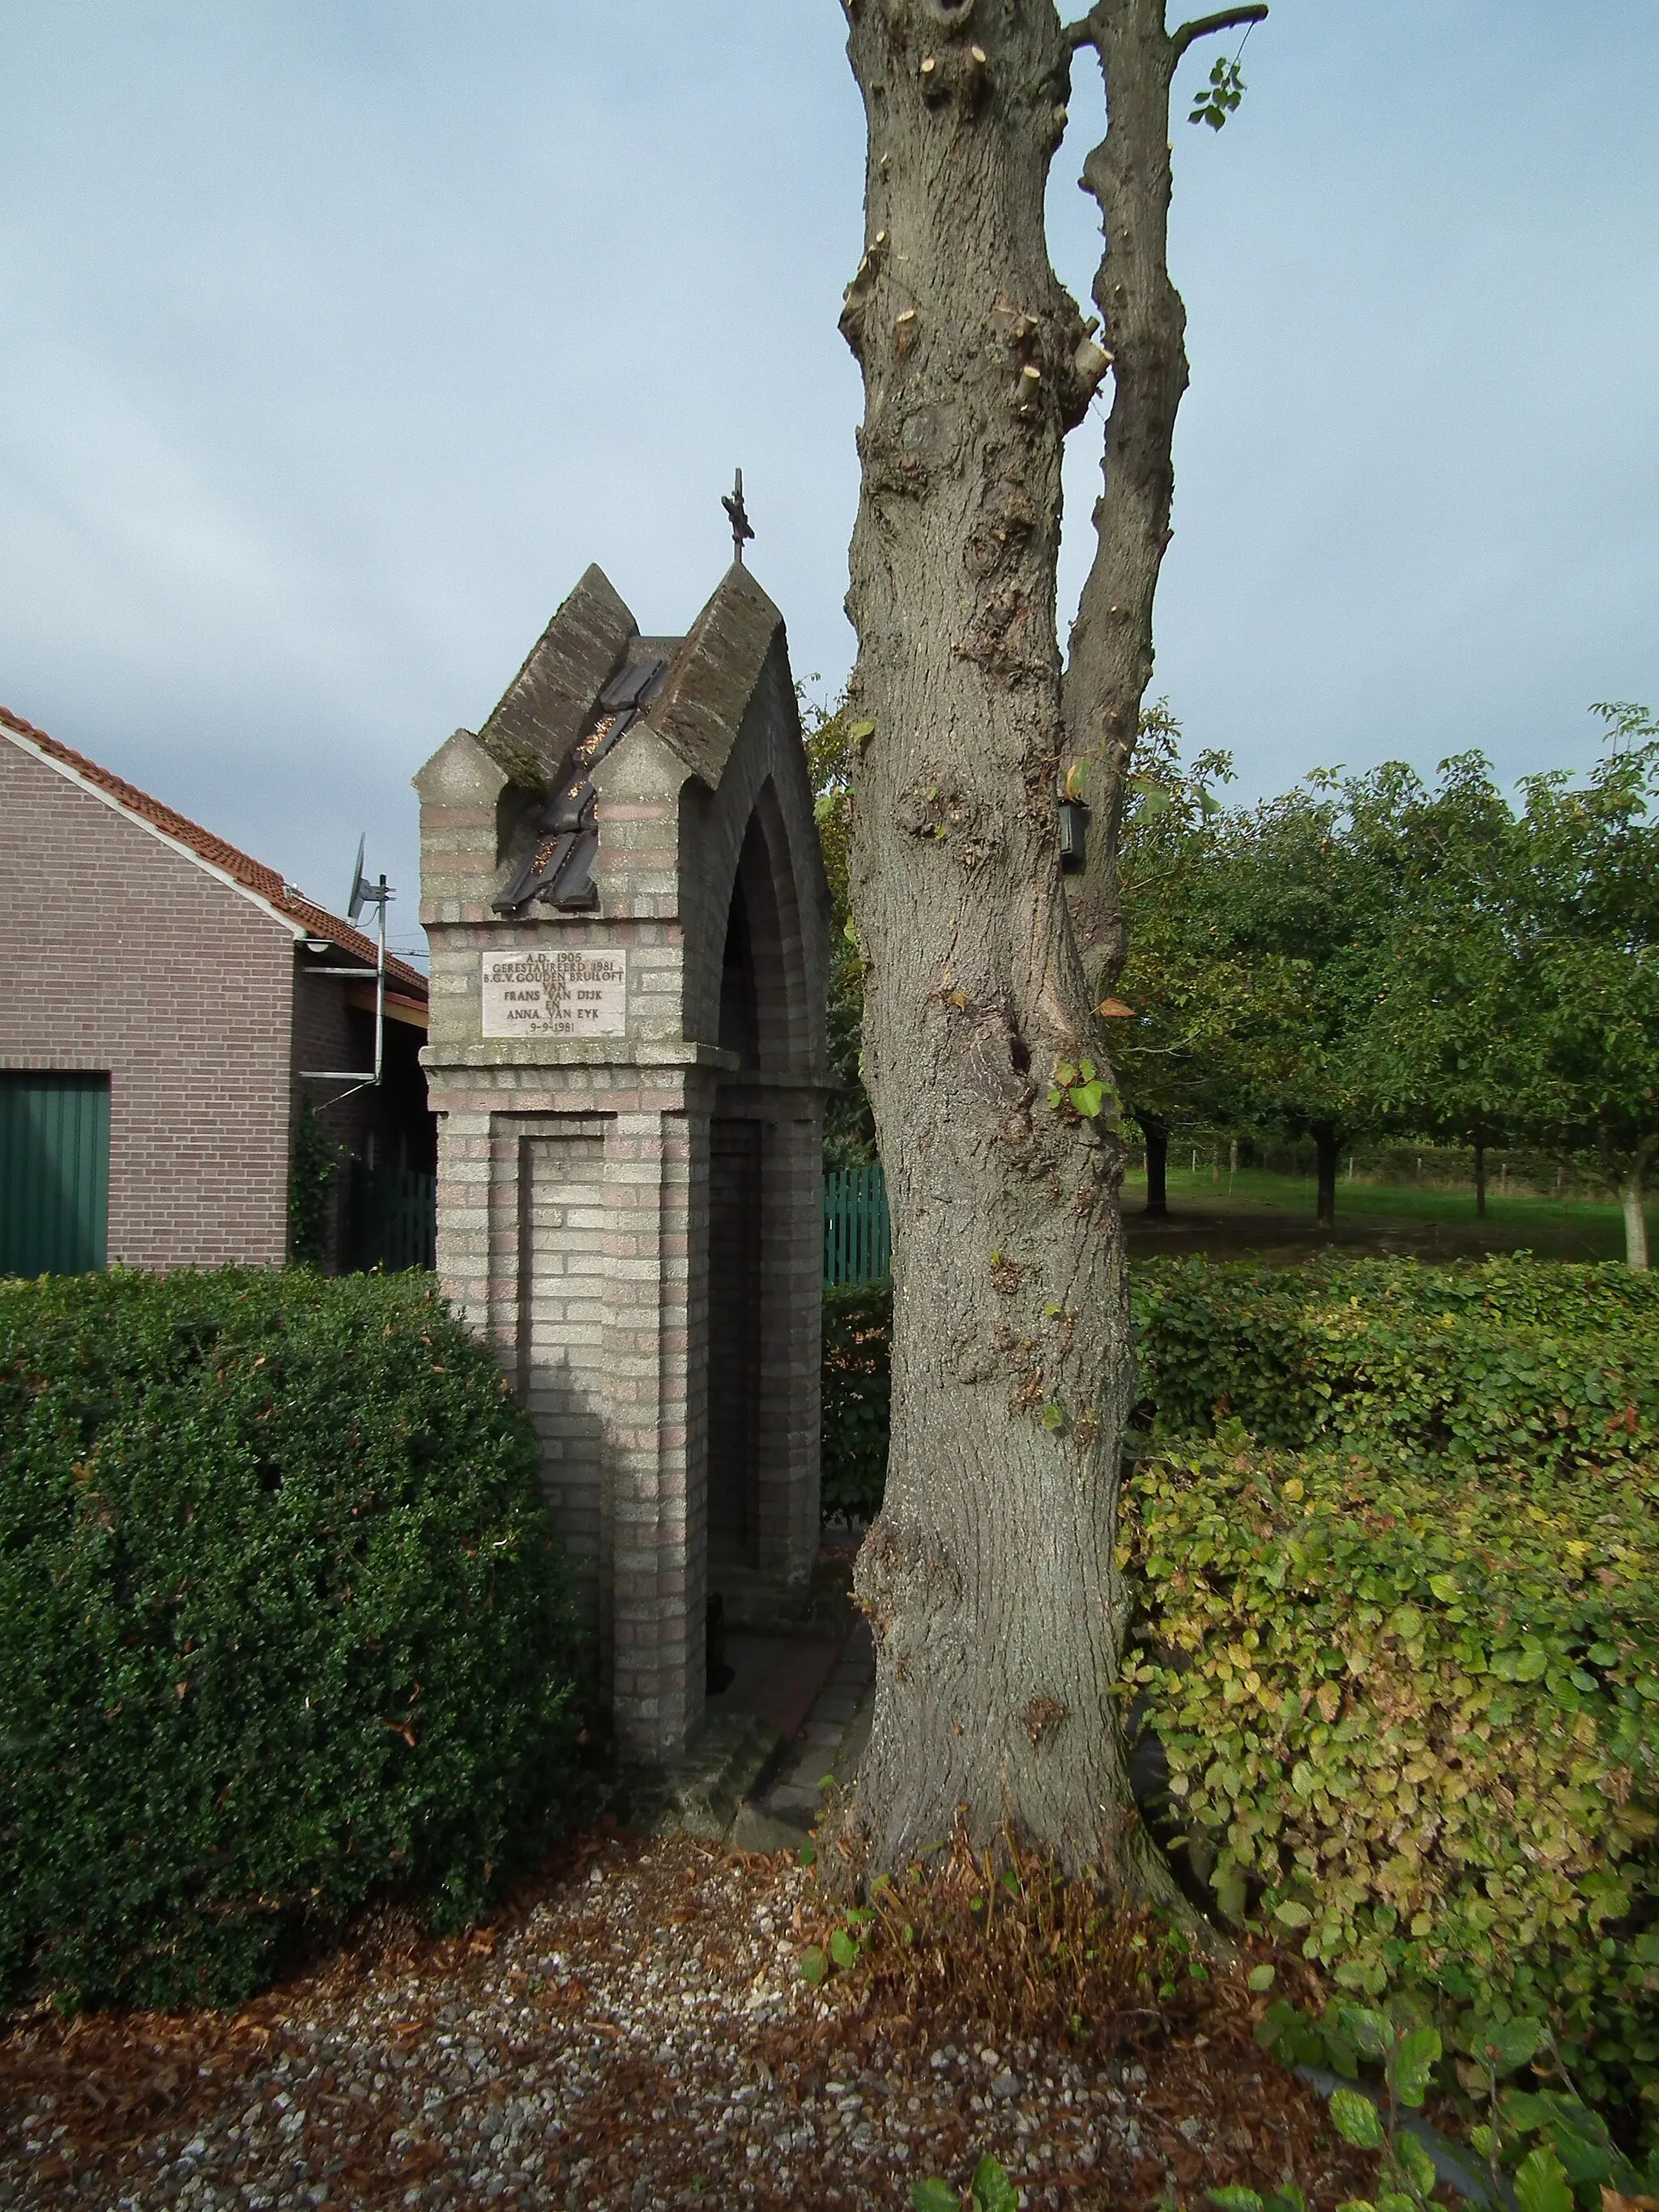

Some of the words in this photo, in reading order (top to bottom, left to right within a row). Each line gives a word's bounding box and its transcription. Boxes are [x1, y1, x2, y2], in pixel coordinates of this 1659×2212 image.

[527, 953, 550, 962] A.D.
[493, 963, 585, 973] GERESTAUREERD
[592, 962, 613, 971] 1981
[569, 972, 624, 982] BRUILOFT
[543, 982, 565, 991] VAN
[504, 991, 539, 1000] FRANS
[548, 991, 571, 1000] VAN
[577, 991, 602, 999] DIJK
[546, 1001, 560, 1010] EN
[507, 1010, 539, 1019] ANNA
[548, 1010, 571, 1019] VAN
[578, 1009, 599, 1018] EYK
